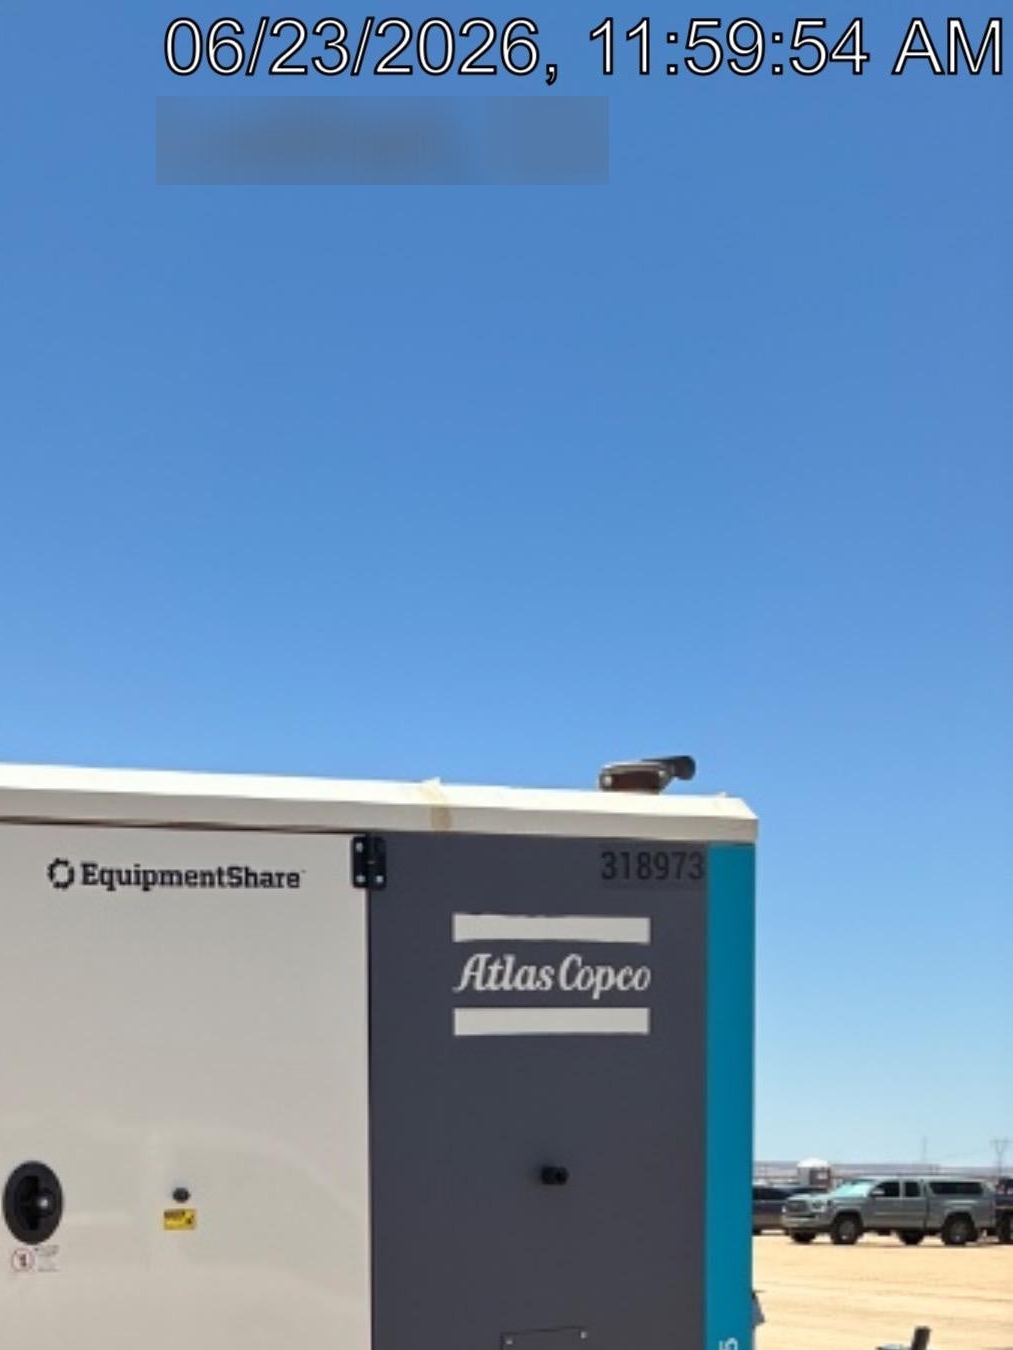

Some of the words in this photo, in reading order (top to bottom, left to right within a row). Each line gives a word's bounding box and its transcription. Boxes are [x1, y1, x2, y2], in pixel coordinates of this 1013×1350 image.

[80, 862, 301, 891] EquipmentShare
[601, 851, 705, 880] 318973
[453, 953, 555, 993] Atlas
[559, 953, 651, 999] Copco
